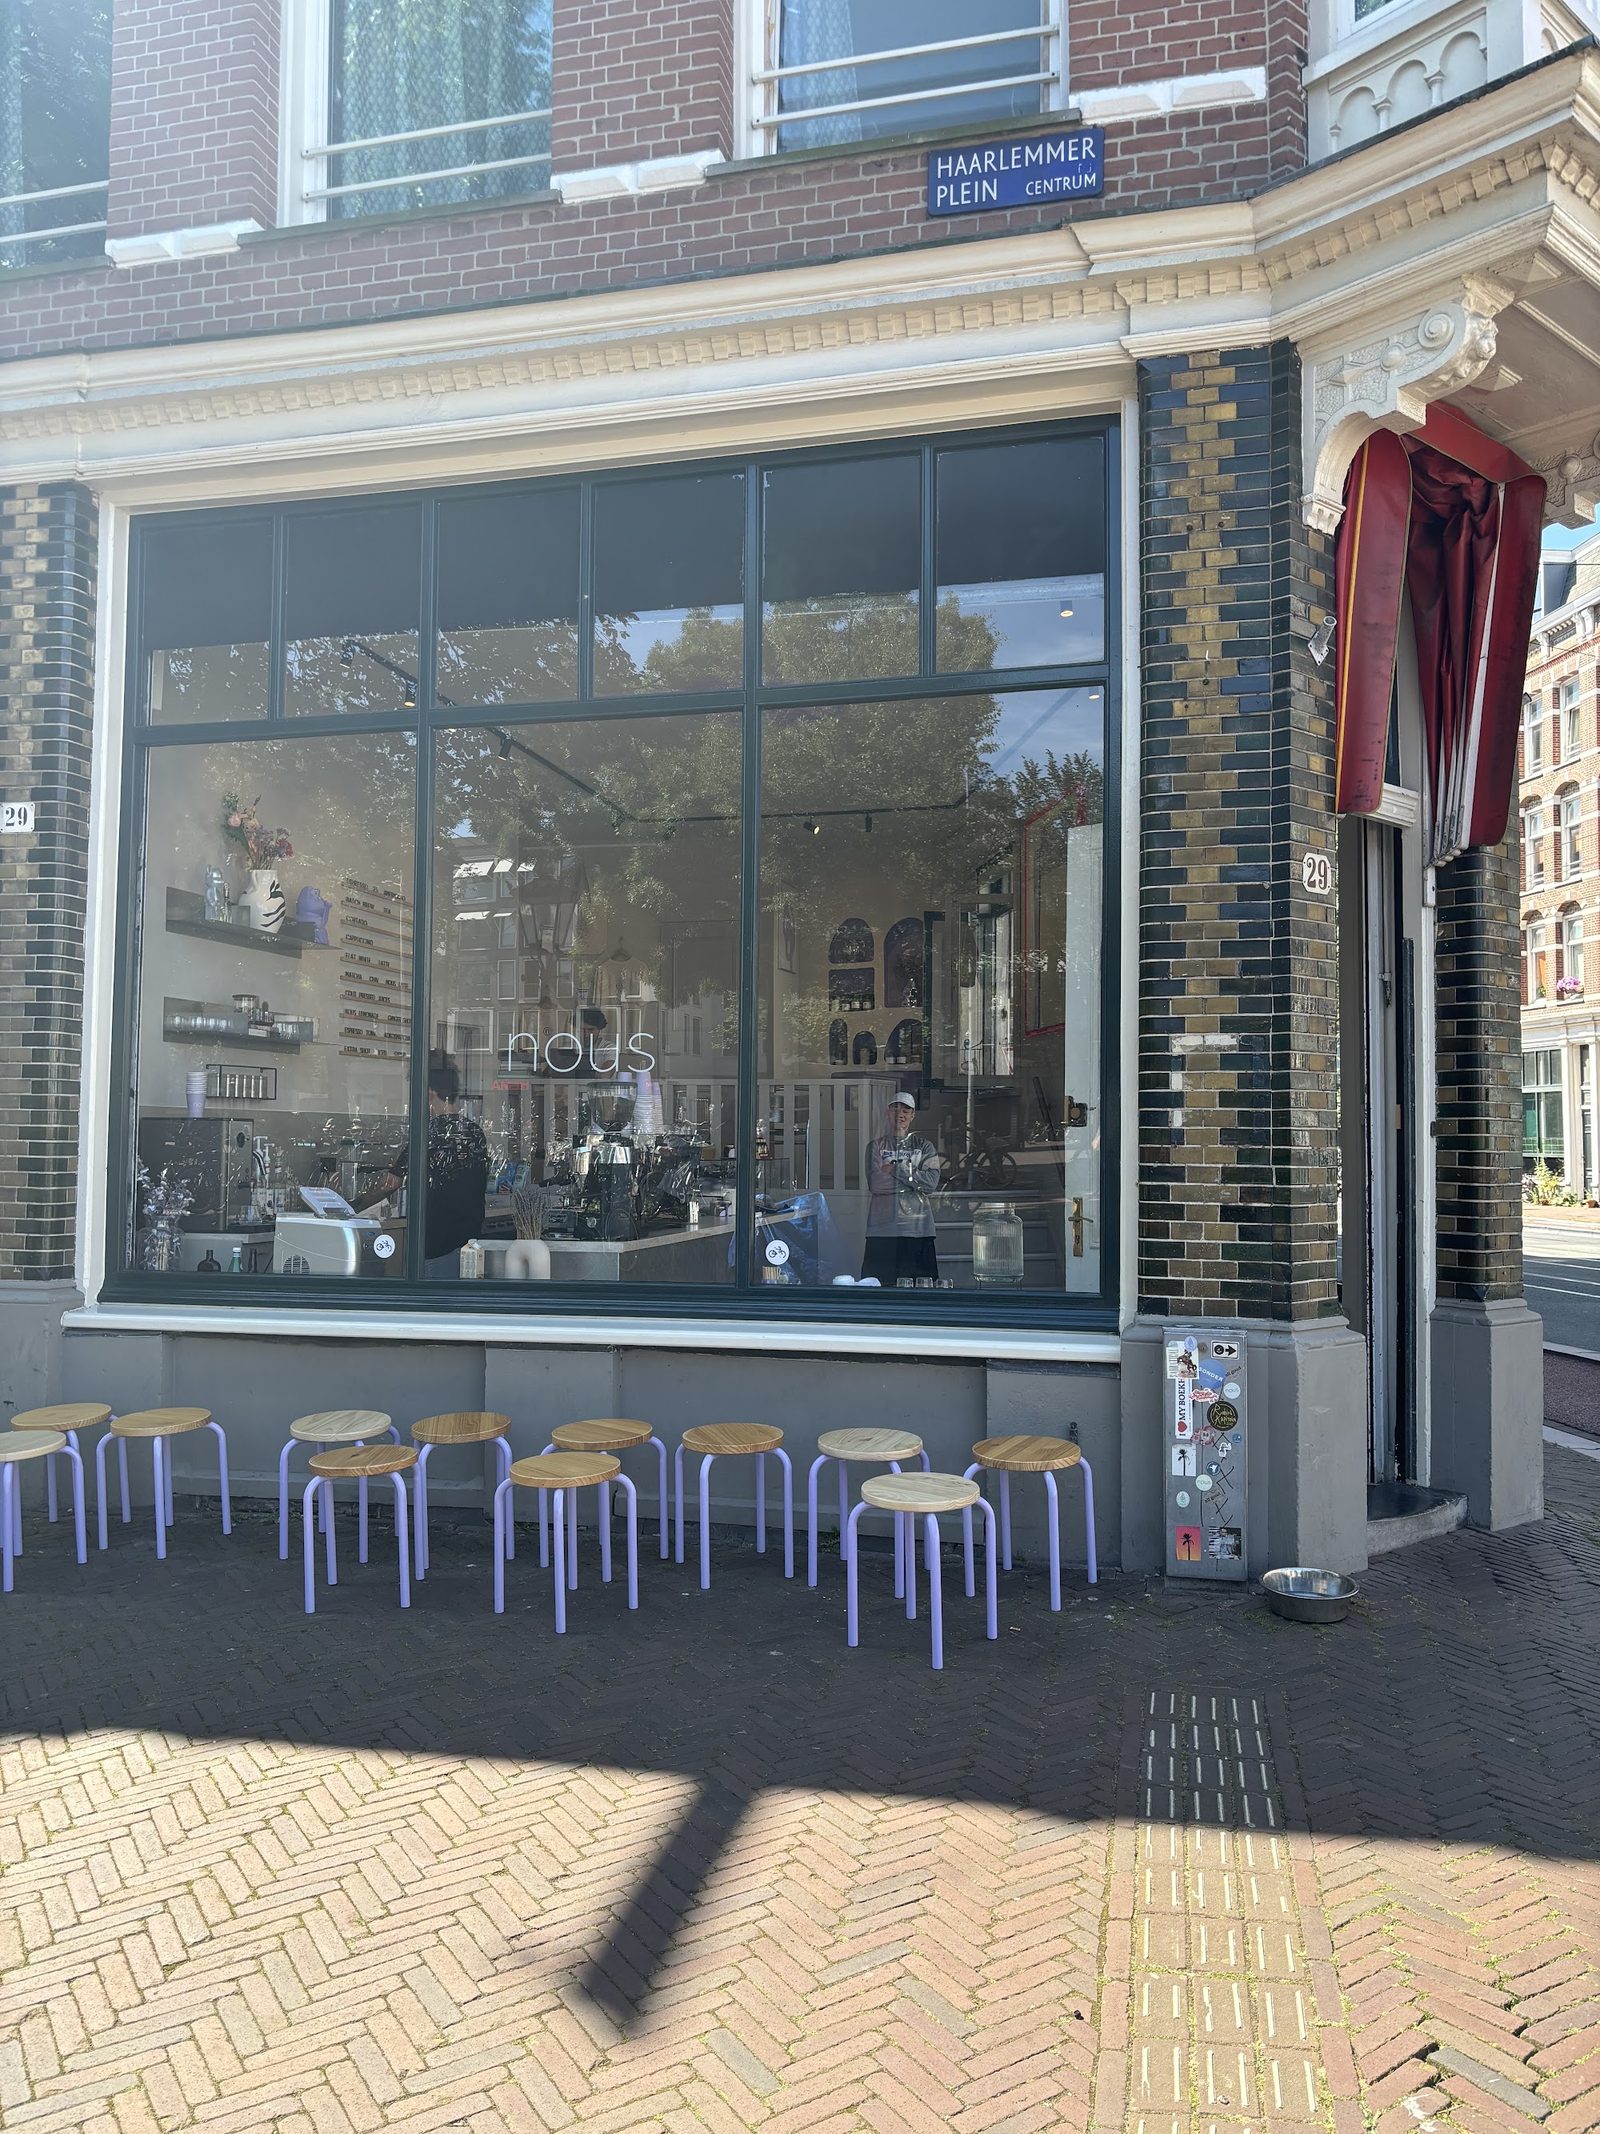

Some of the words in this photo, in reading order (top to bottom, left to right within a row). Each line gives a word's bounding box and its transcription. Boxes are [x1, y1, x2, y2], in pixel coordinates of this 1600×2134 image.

[937, 136, 1096, 179] HAARLEMMER
[936, 178, 998, 208] PLEIN
[1025, 172, 1096, 197] CENTRUM
[5, 806, 28, 827] 29
[1306, 856, 1328, 891] 29
[508, 1032, 656, 1073] nous
[1199, 1366, 1224, 1382] SONDER
[1178, 1406, 1186, 1421] MY
